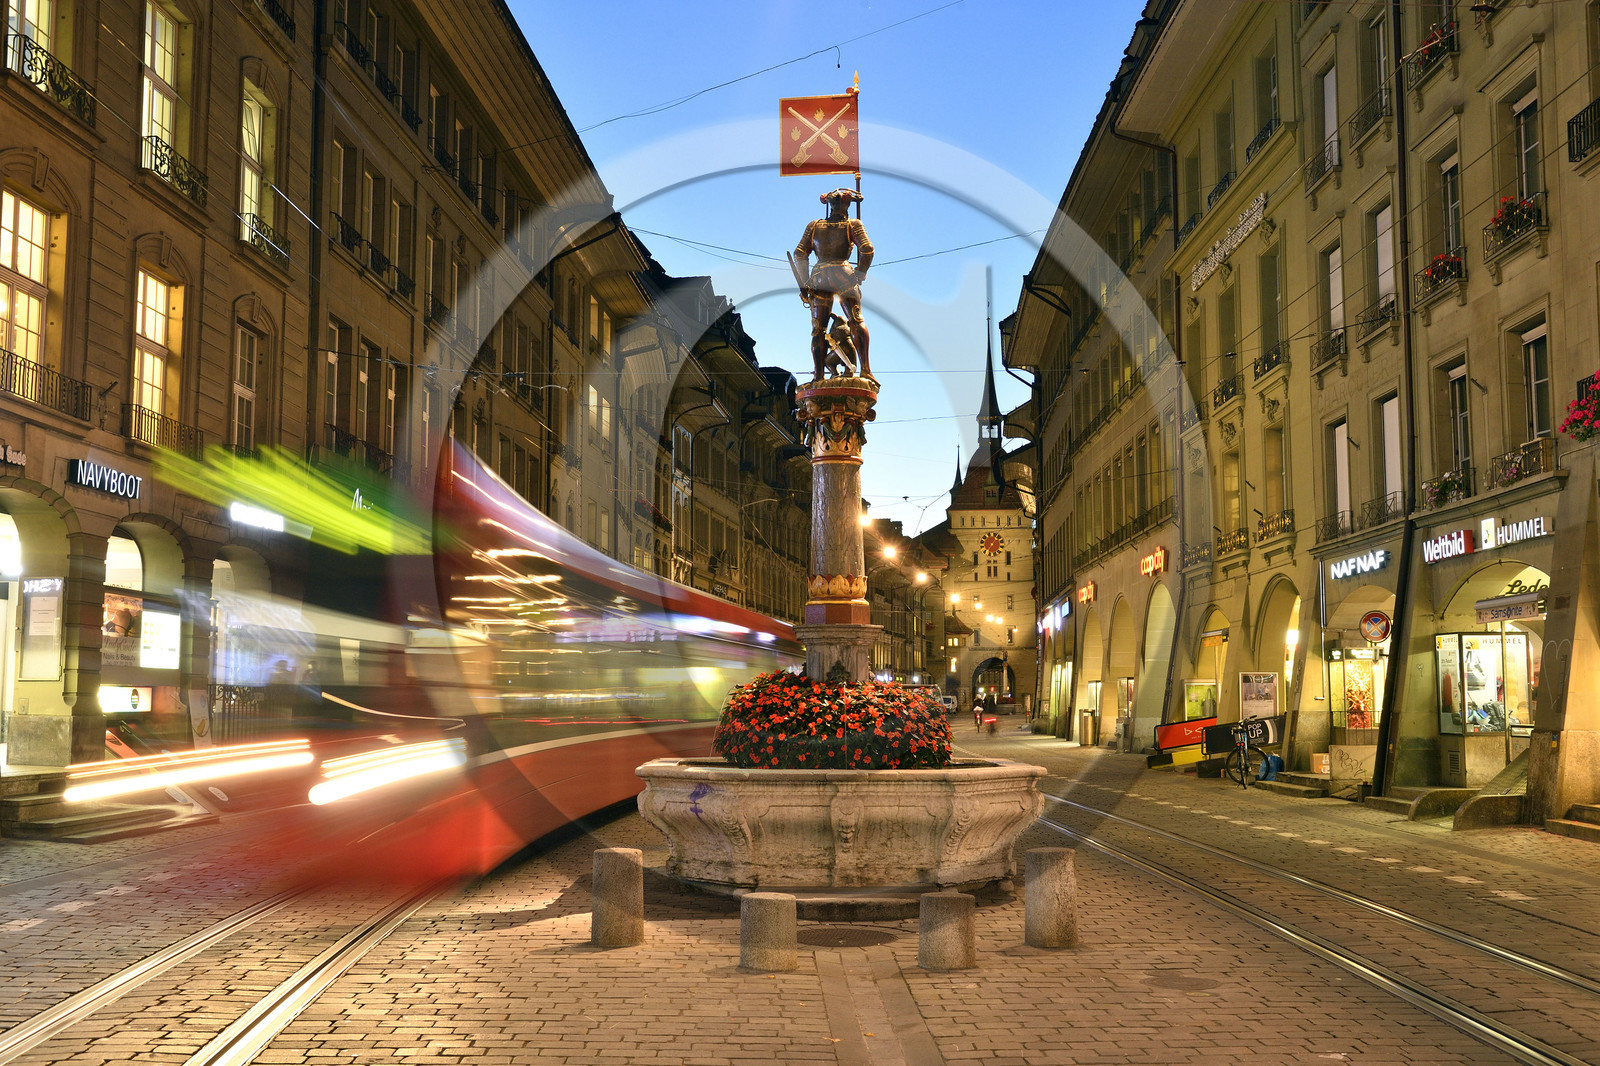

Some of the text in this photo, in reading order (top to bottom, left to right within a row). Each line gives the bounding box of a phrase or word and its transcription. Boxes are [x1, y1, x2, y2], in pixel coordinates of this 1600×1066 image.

[77, 459, 142, 499] NAVYBOOT
[1496, 516, 1548, 545] HUMMEL
[1423, 529, 1466, 563] Weltbild
[1247, 722, 1262, 731] POP
[1248, 729, 1263, 739] UP
